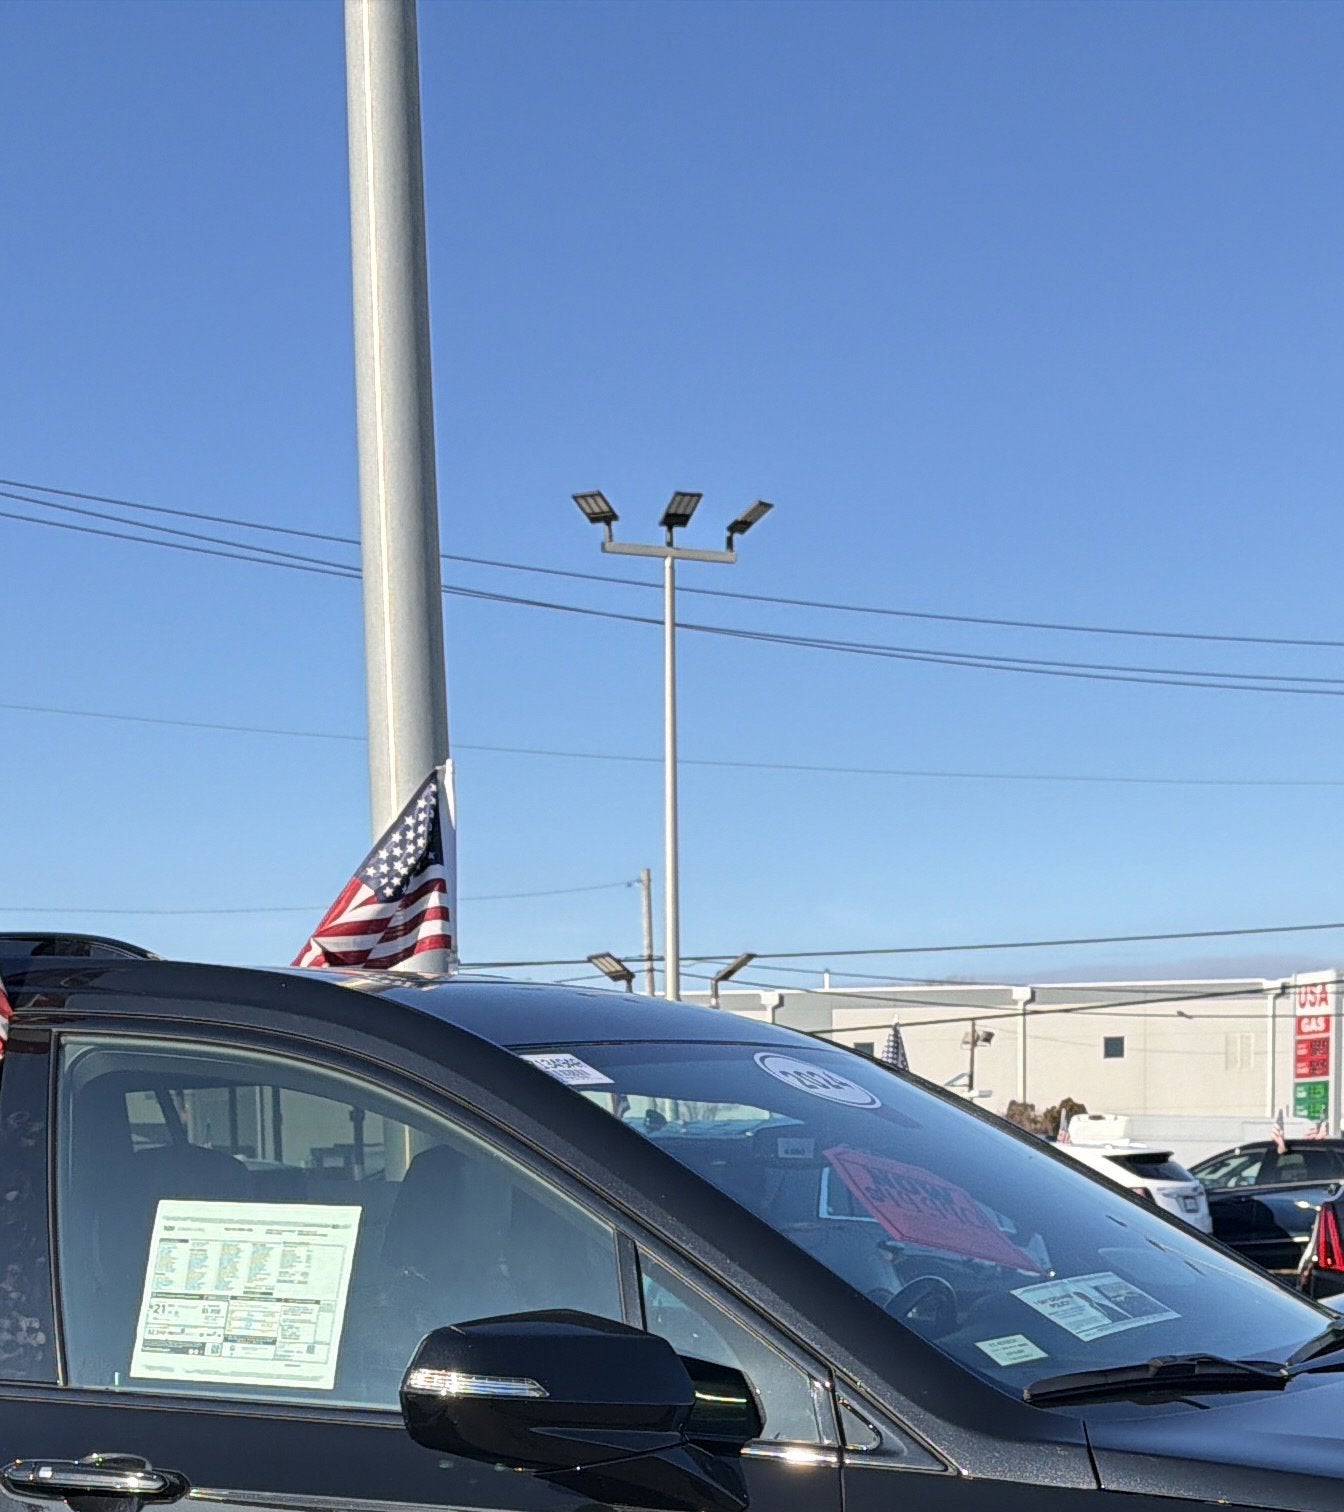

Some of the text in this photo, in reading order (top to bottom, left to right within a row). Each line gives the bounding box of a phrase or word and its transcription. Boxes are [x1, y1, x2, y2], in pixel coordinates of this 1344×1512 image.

[1297, 983, 1329, 1009] USA
[1301, 1018, 1326, 1032] GAS
[778, 1070, 855, 1089] 2024
